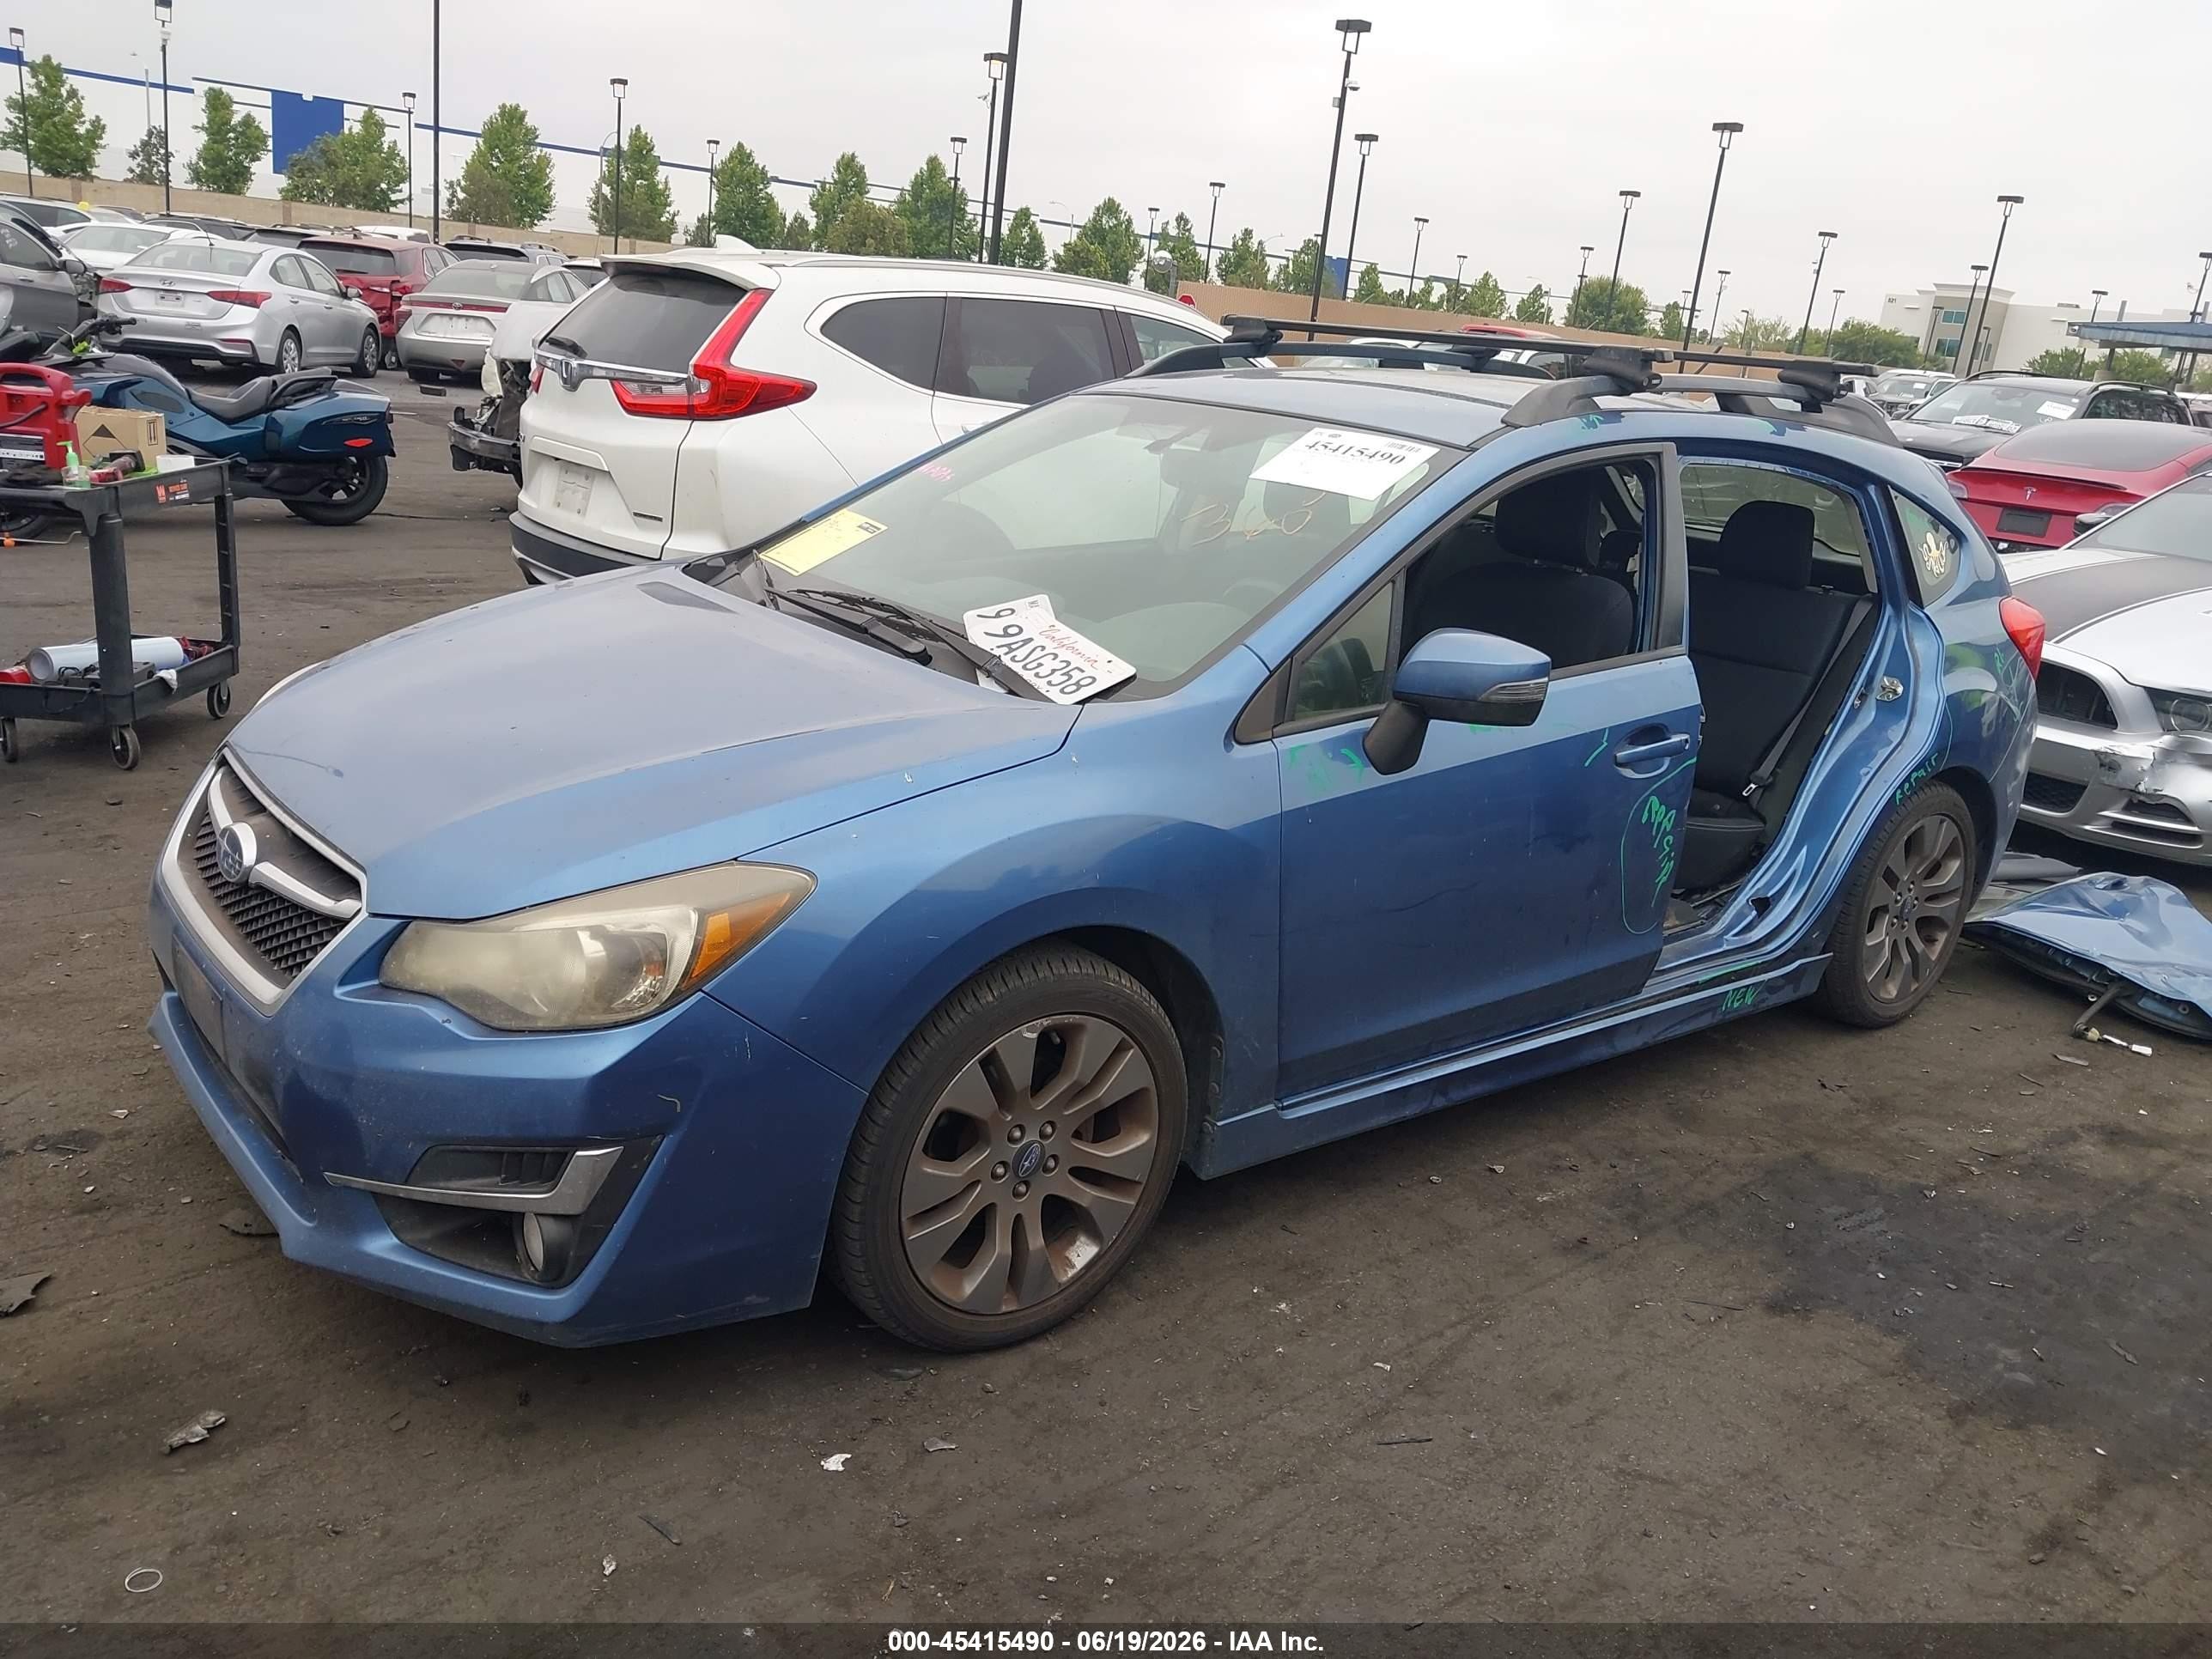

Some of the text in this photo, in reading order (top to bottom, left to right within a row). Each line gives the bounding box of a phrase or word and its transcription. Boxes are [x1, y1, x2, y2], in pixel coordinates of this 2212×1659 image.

[1304, 440, 1406, 465] 45415490
[982, 623, 1097, 696] 9ASG358
[1038, 627, 1099, 671] California
